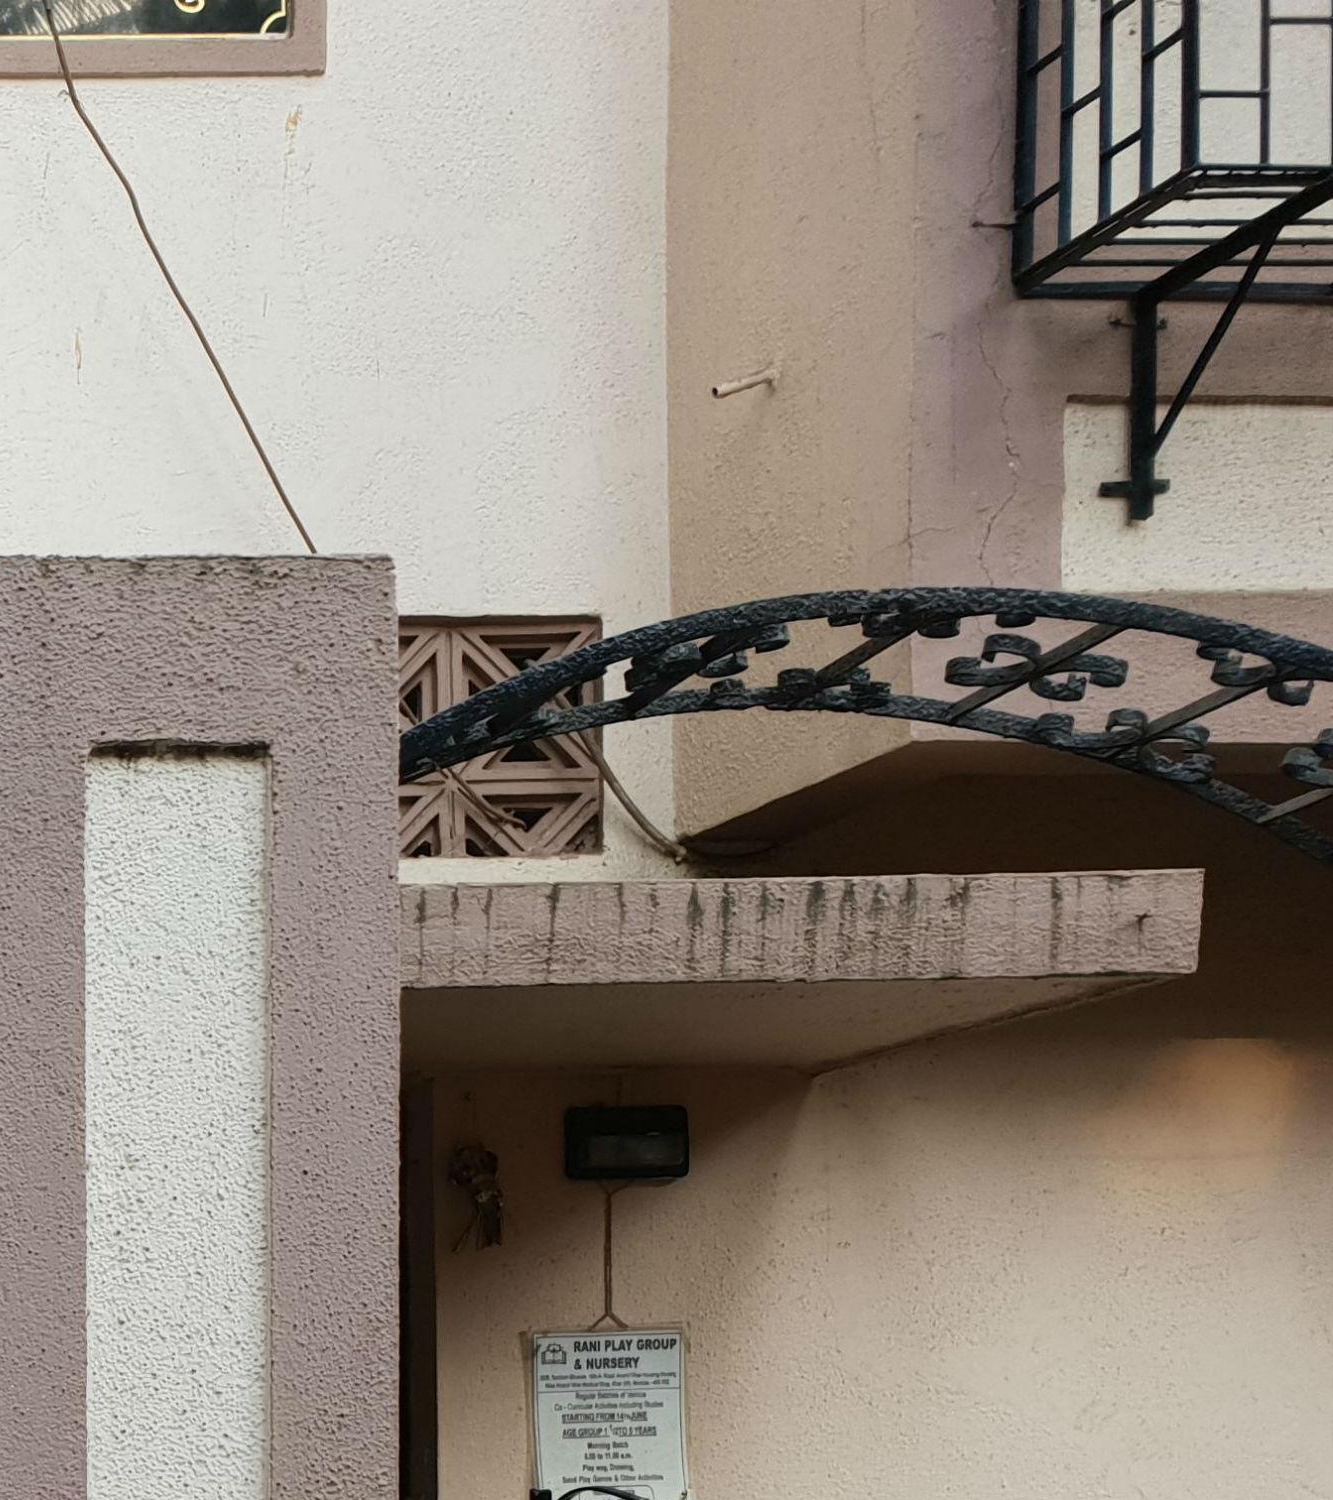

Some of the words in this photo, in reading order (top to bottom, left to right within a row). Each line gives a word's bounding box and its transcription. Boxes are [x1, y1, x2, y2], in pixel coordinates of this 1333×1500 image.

[574, 1341, 600, 1352] RANI
[605, 1340, 632, 1351] PLAY
[636, 1338, 677, 1350] GROUP
[586, 1357, 640, 1369] NURSERY
